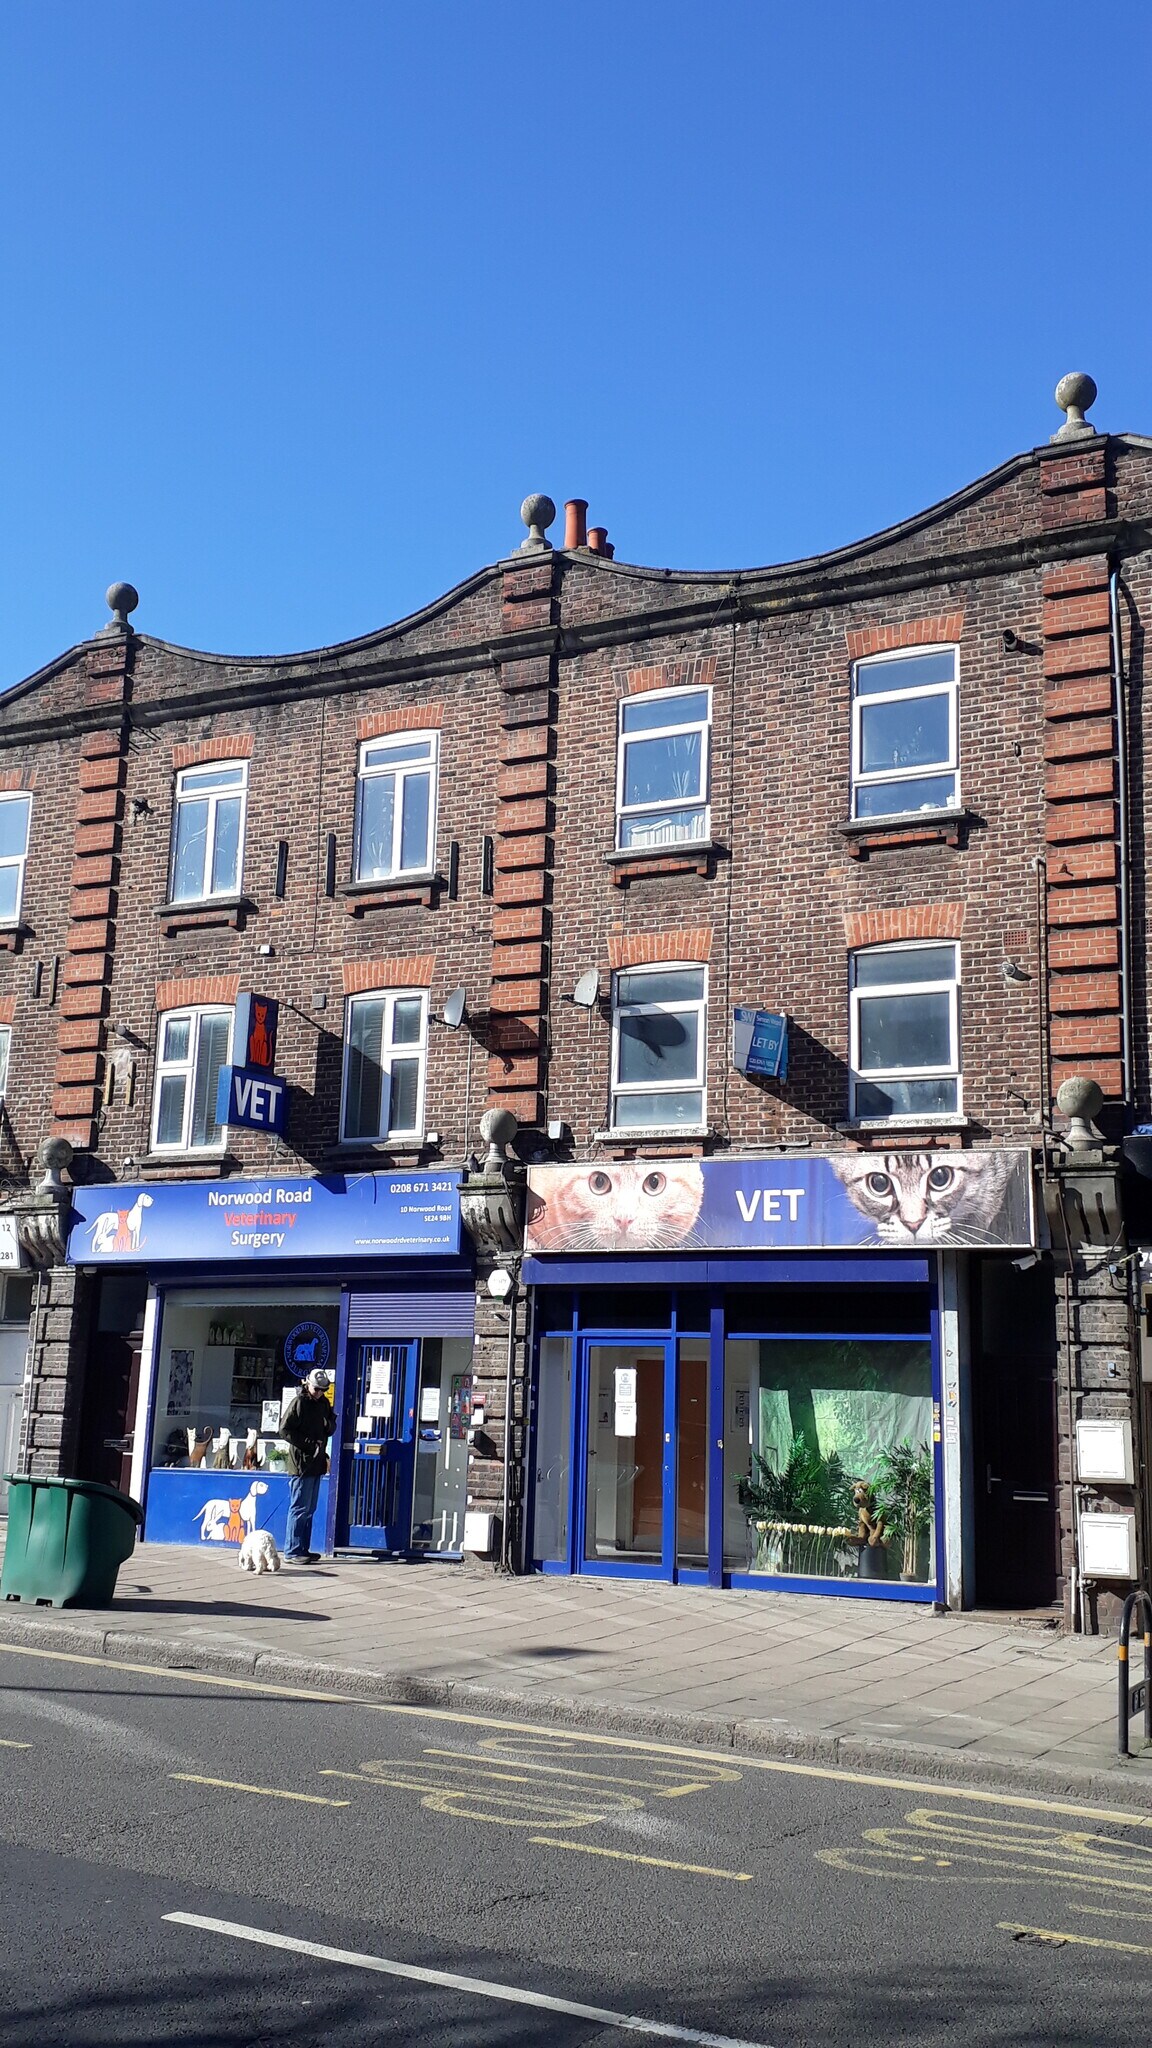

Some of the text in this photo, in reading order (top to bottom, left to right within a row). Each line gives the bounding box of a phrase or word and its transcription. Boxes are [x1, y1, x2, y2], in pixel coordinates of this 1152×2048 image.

[752, 1037, 780, 1051] LET BY
[234, 1075, 283, 1124] VET
[390, 1181, 453, 1194] 0208 671 3421
[208, 1186, 312, 1206] Norwood Road
[408, 1205, 436, 1213] Norwood
[436, 1204, 452, 1212] Road
[735, 1188, 805, 1222] VET
[224, 1210, 297, 1228] Veterinary
[2, 1223, 11, 1232] 12
[231, 1230, 286, 1248] Surgery
[354, 1235, 450, 1246] www.norwoodrdveterinary.co.uk
